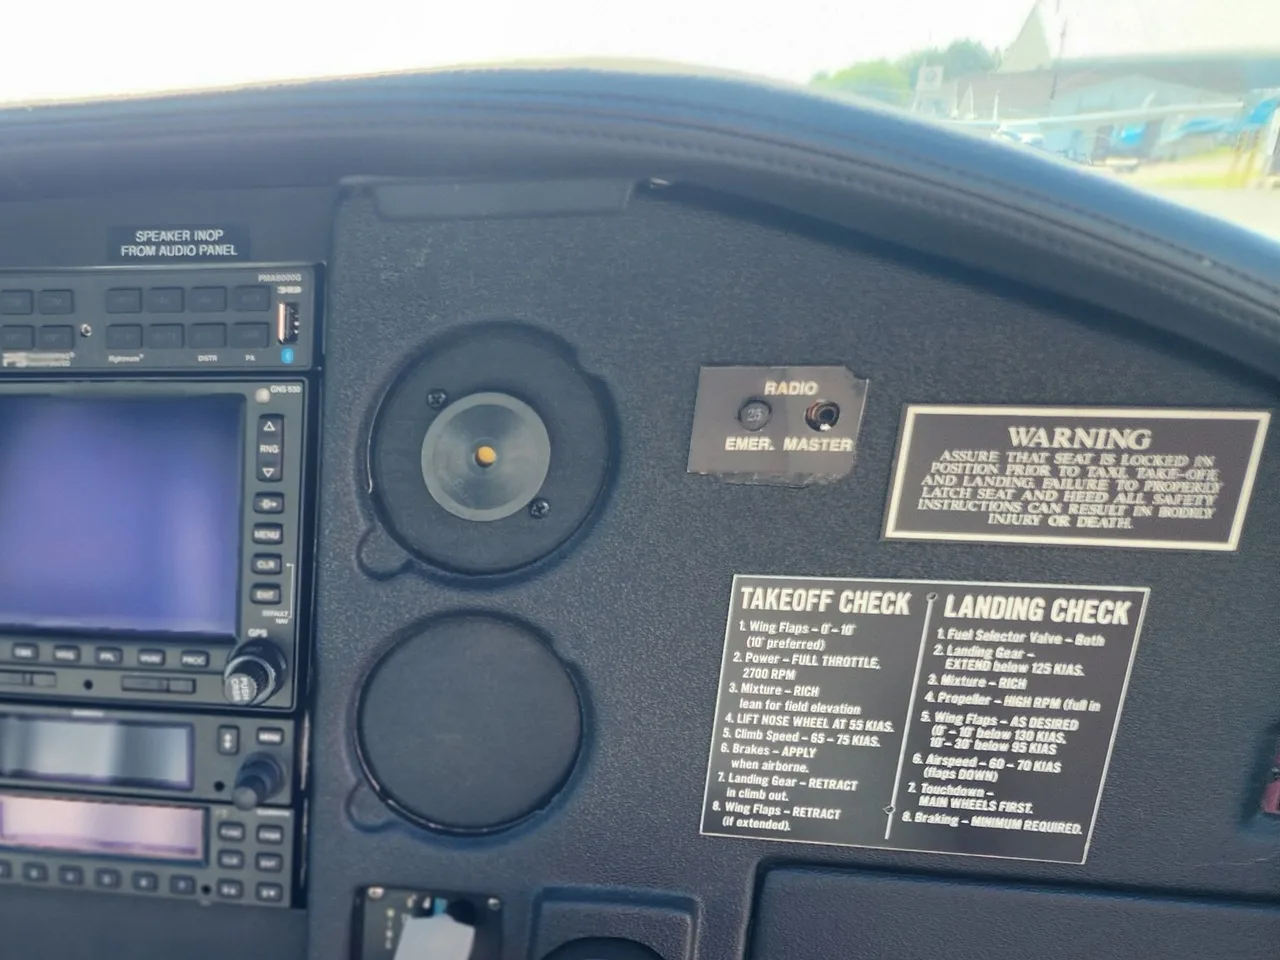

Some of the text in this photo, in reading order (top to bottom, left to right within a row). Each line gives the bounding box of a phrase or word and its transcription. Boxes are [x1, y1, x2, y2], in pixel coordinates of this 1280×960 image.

[136, 230, 224, 242] SPEAKER INOP
[121, 244, 238, 256] FROM AUDIO PANEL
[764, 380, 819, 396] RADIO
[724, 436, 854, 452] EMER. MASTER
[1008, 426, 1152, 450] WARNING
[260, 444, 278, 454] RNG
[940, 450, 1216, 468] ASSURE THAT SEAT IS LOCKED IN
[931, 462, 1000, 474] POSITION
[1006, 464, 1052, 476] PRIOR
[1058, 466, 1081, 478] TO
[921, 474, 958, 486] AND
[1042, 478, 1111, 491] FAILURE
[1116, 480, 1140, 492] TO
[1144, 480, 1224, 494] PROPERLY
[922, 487, 1218, 506] LATCH SEAT AND HEED ALL SAFETY
[917, 498, 1216, 520] INSTRUCTIONS CAN RESULT IN BODILY
[988, 513, 1042, 526] INJURY
[1048, 515, 1072, 528] OR
[254, 531, 280, 540] MENU
[741, 587, 912, 615] TAKEOFF CHECK
[944, 594, 1132, 625] LANDING CHECK
[248, 629, 268, 638] GPS
[750, 621, 809, 635] Wing Flaps
[767, 638, 825, 651] preferred)
[947, 628, 1105, 647] Fuel Selector Valve Both
[745, 653, 780, 664] Power
[792, 655, 819, 666] FULL
[947, 644, 1025, 660] Landing Gear
[743, 669, 796, 680] 2700 RPM
[945, 659, 992, 671] EXTEND
[993, 661, 1029, 673] below
[1032, 663, 1051, 675] 125
[741, 683, 820, 697] Mixture RICH
[940, 674, 1028, 690] Mixture RICH
[740, 698, 861, 715] lean for field elevation
[938, 691, 1101, 712] Propeller HIGH RPM (full in
[737, 714, 759, 724] LIFT
[762, 715, 789, 727] NOSE
[793, 717, 829, 728] WHEEL
[832, 719, 846, 730] AT
[849, 720, 864, 731] 55
[935, 711, 1080, 731] Wing Flaps AS DESIRED
[735, 728, 763, 740] Climb
[766, 730, 799, 742] Speed
[811, 733, 825, 743] 65
[837, 734, 850, 745] 75
[976, 727, 1012, 740] below
[1015, 730, 1035, 742] 130
[733, 743, 817, 758] Brakes APPLY
[974, 739, 1057, 755] below 95 KIAS
[732, 758, 809, 773] when airborne.
[925, 753, 1062, 773] Airspeed 60 70 KIAS
[728, 772, 858, 791] Landing Gear RETRACT
[923, 767, 999, 783] (flaps DOWN)
[726, 787, 789, 801] in climb out.
[921, 782, 985, 797] Touchdown
[726, 802, 841, 820] Wing Flaps RETRACT
[919, 795, 948, 808] MAIN
[950, 797, 998, 811] WHEELS
[722, 816, 791, 831] (if extended).
[915, 812, 960, 827] Braking
[971, 816, 1022, 830] MINIMUM
